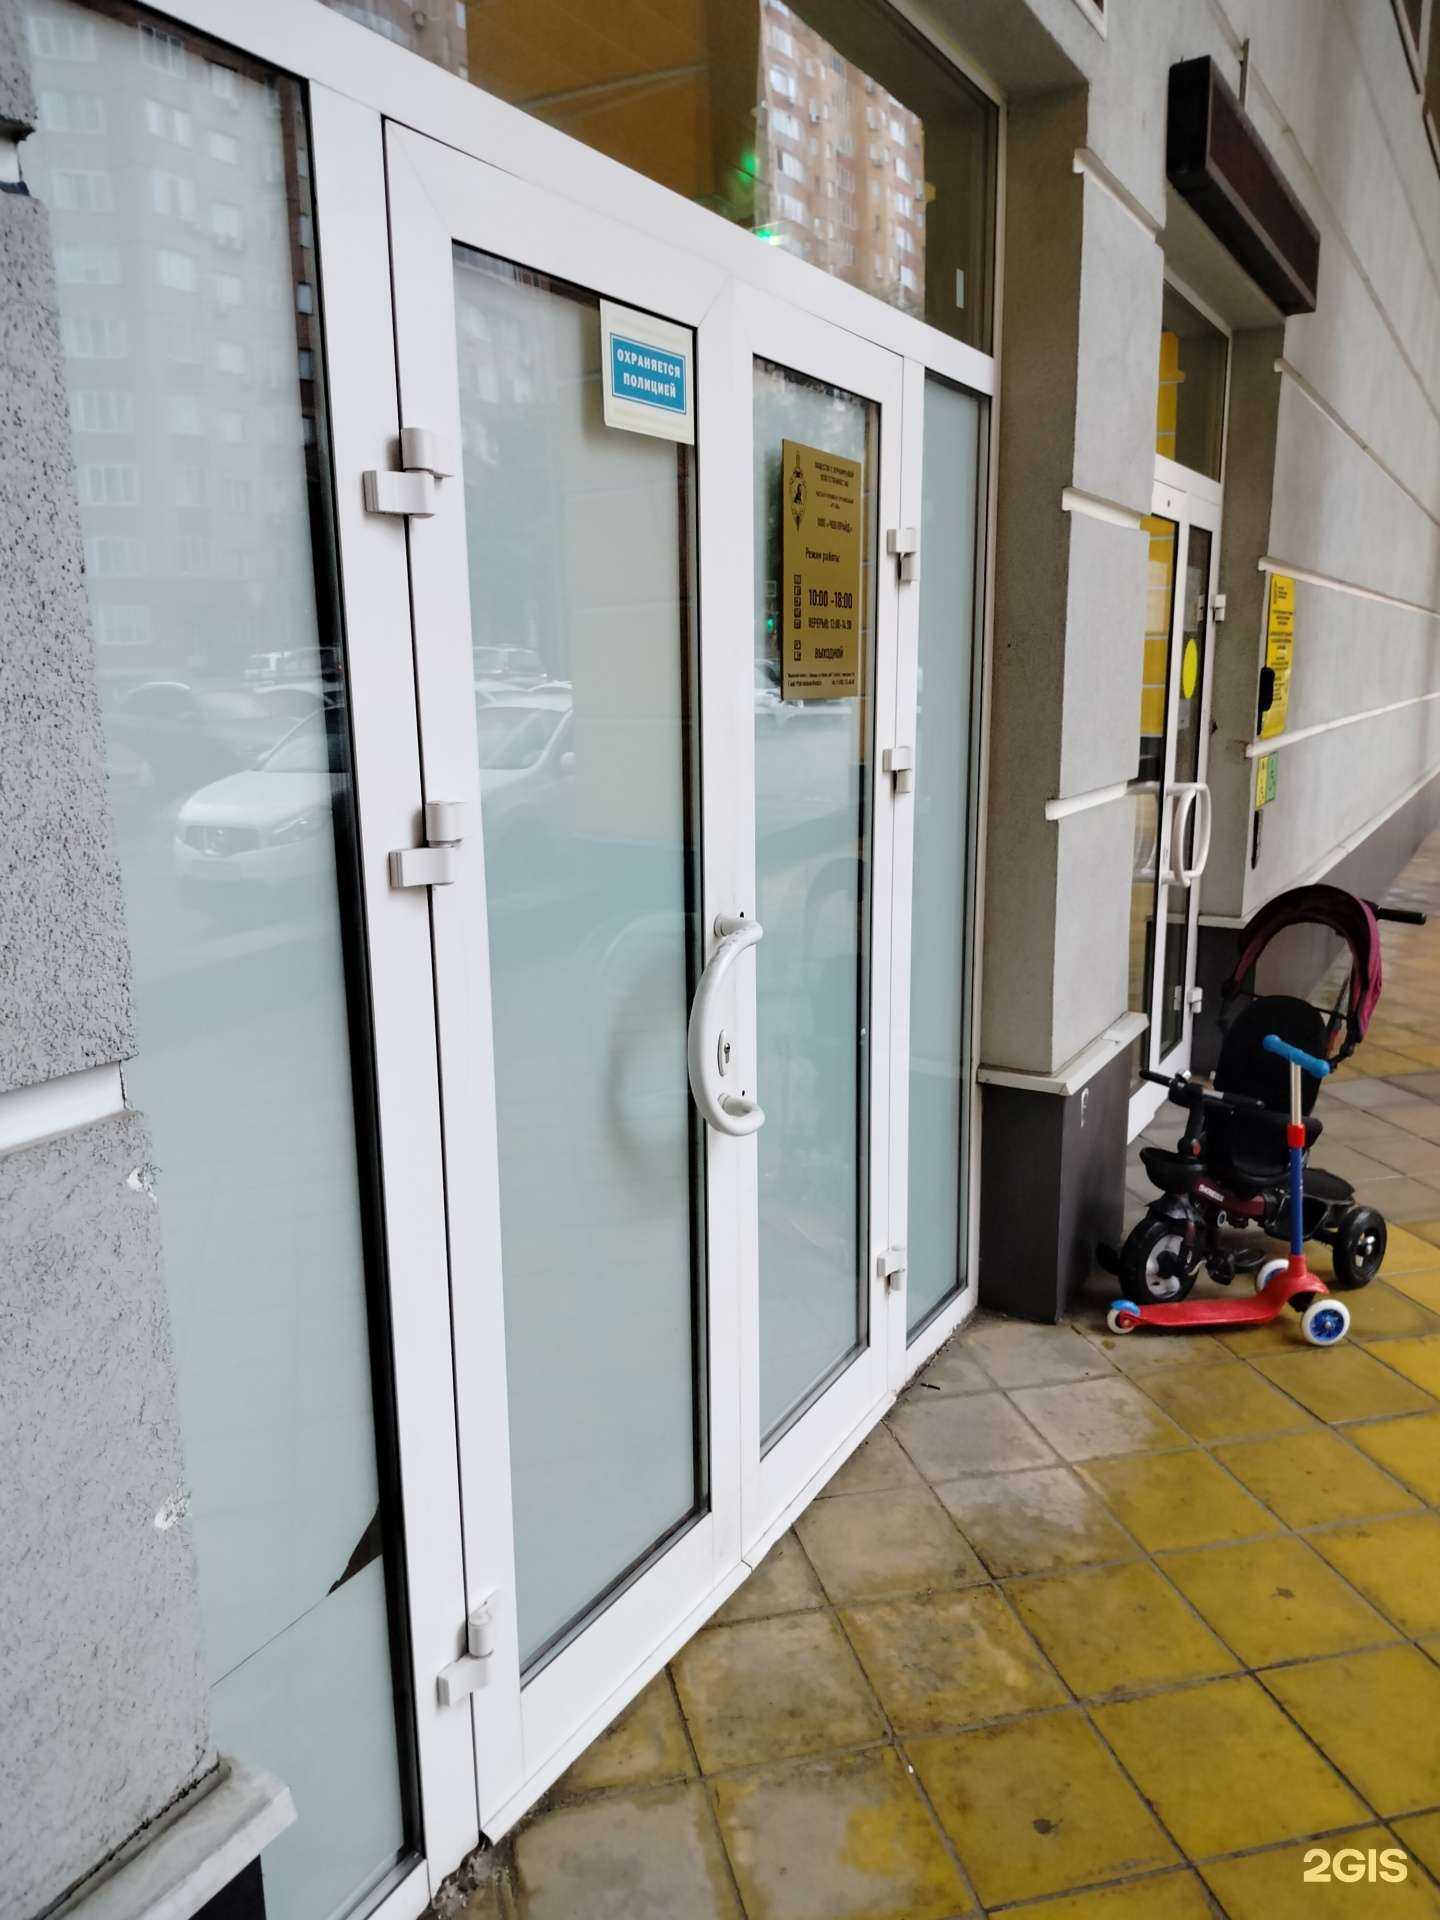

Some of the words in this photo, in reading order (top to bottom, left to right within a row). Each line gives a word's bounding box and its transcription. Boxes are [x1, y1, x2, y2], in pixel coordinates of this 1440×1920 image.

[617, 348, 681, 379] ОХРАНЯЕТСЯ
[623, 372, 677, 398] ПОЛИЦИЕЙ
[809, 589, 828, 607] 10:00
